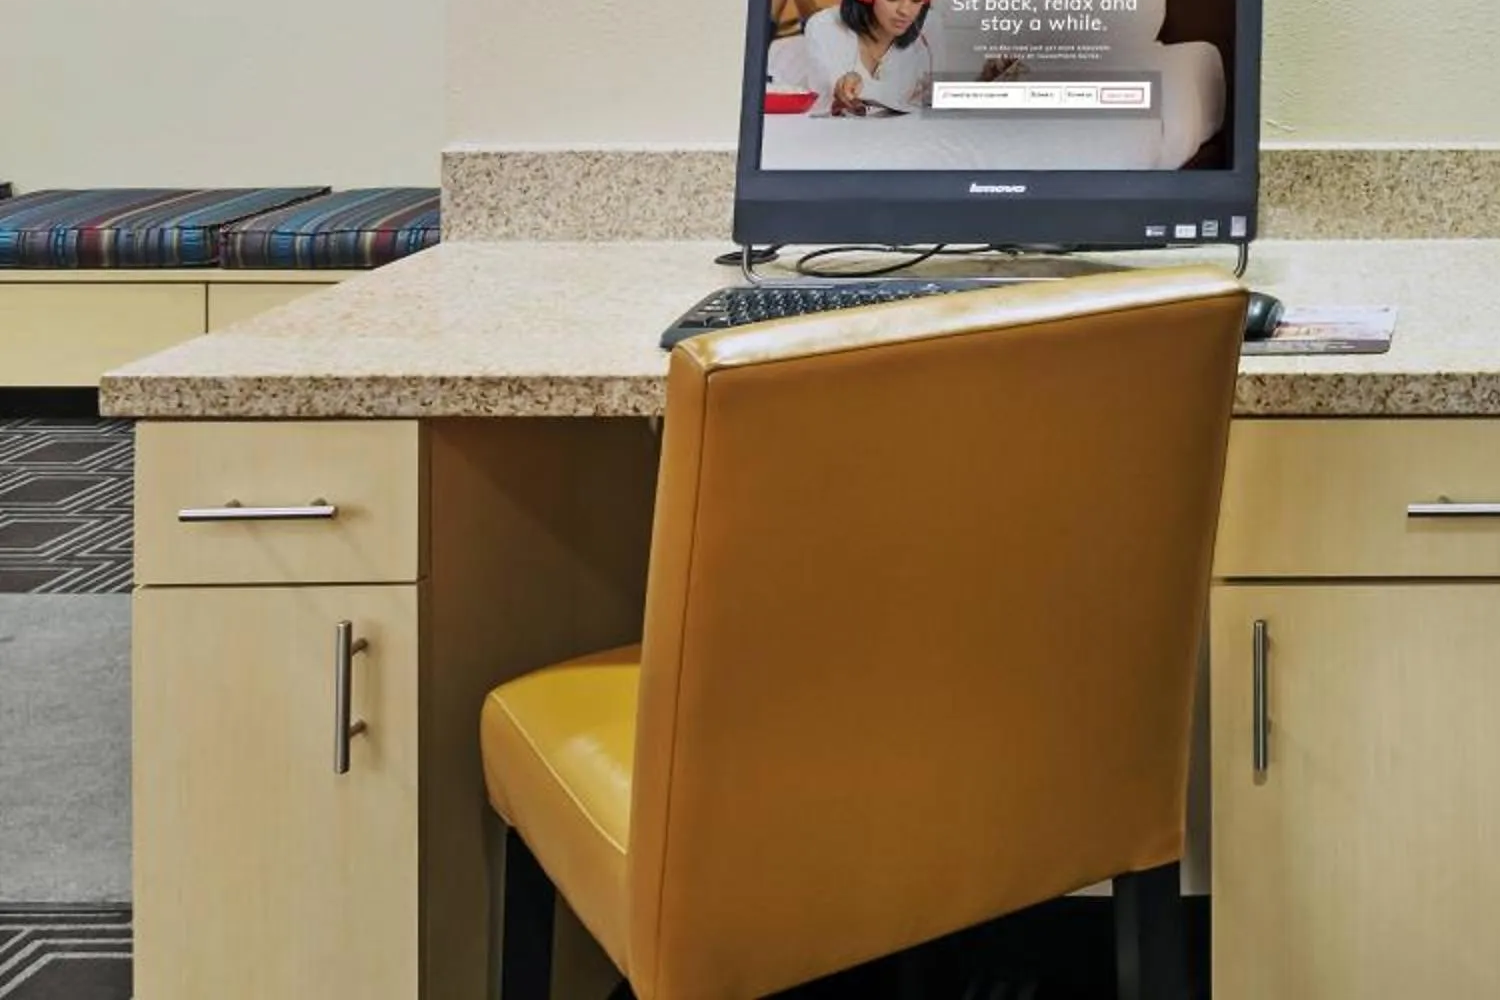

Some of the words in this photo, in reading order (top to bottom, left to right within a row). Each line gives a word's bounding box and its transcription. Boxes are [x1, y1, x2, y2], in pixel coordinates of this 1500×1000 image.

[980, 16, 1022, 34] stay
[1029, 18, 1041, 31] a
[1050, 15, 1108, 32] while.
